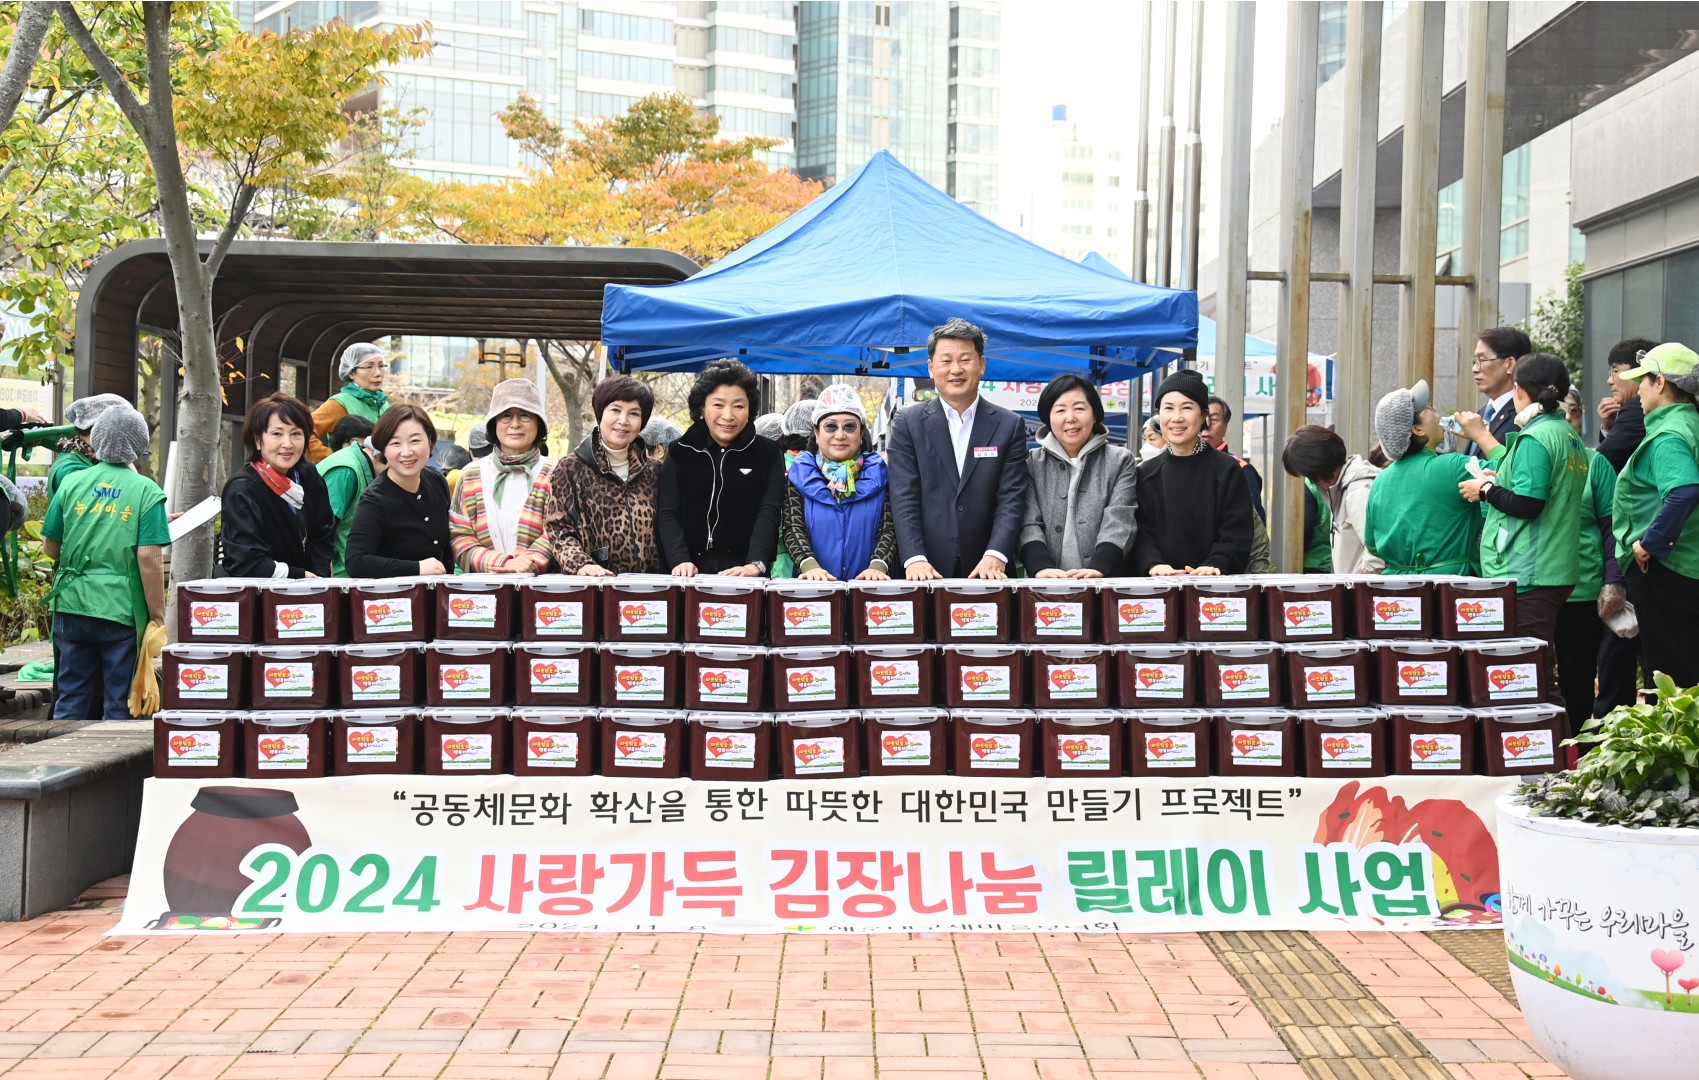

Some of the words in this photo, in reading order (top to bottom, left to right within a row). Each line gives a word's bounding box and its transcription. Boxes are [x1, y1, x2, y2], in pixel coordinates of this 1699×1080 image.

[92, 487, 122, 499] SMU
[394, 791, 571, 827] “공동체문화
[590, 791, 686, 824] 확산을
[706, 788, 767, 822] 통한
[787, 790, 882, 823] 따뜻한
[902, 790, 1027, 823] 대한민국
[1048, 789, 1140, 822] 만들기
[1162, 789, 1301, 821] 프로젝트”
[243, 852, 440, 914] 2024
[465, 851, 742, 917] 사랑가득
[770, 850, 1042, 919] 김장나눔
[1068, 848, 1271, 917] 릴레이
[1300, 852, 1430, 917] 사업
[1538, 897, 1593, 932] 가꾸는
[1600, 905, 1695, 951] 우리마을
